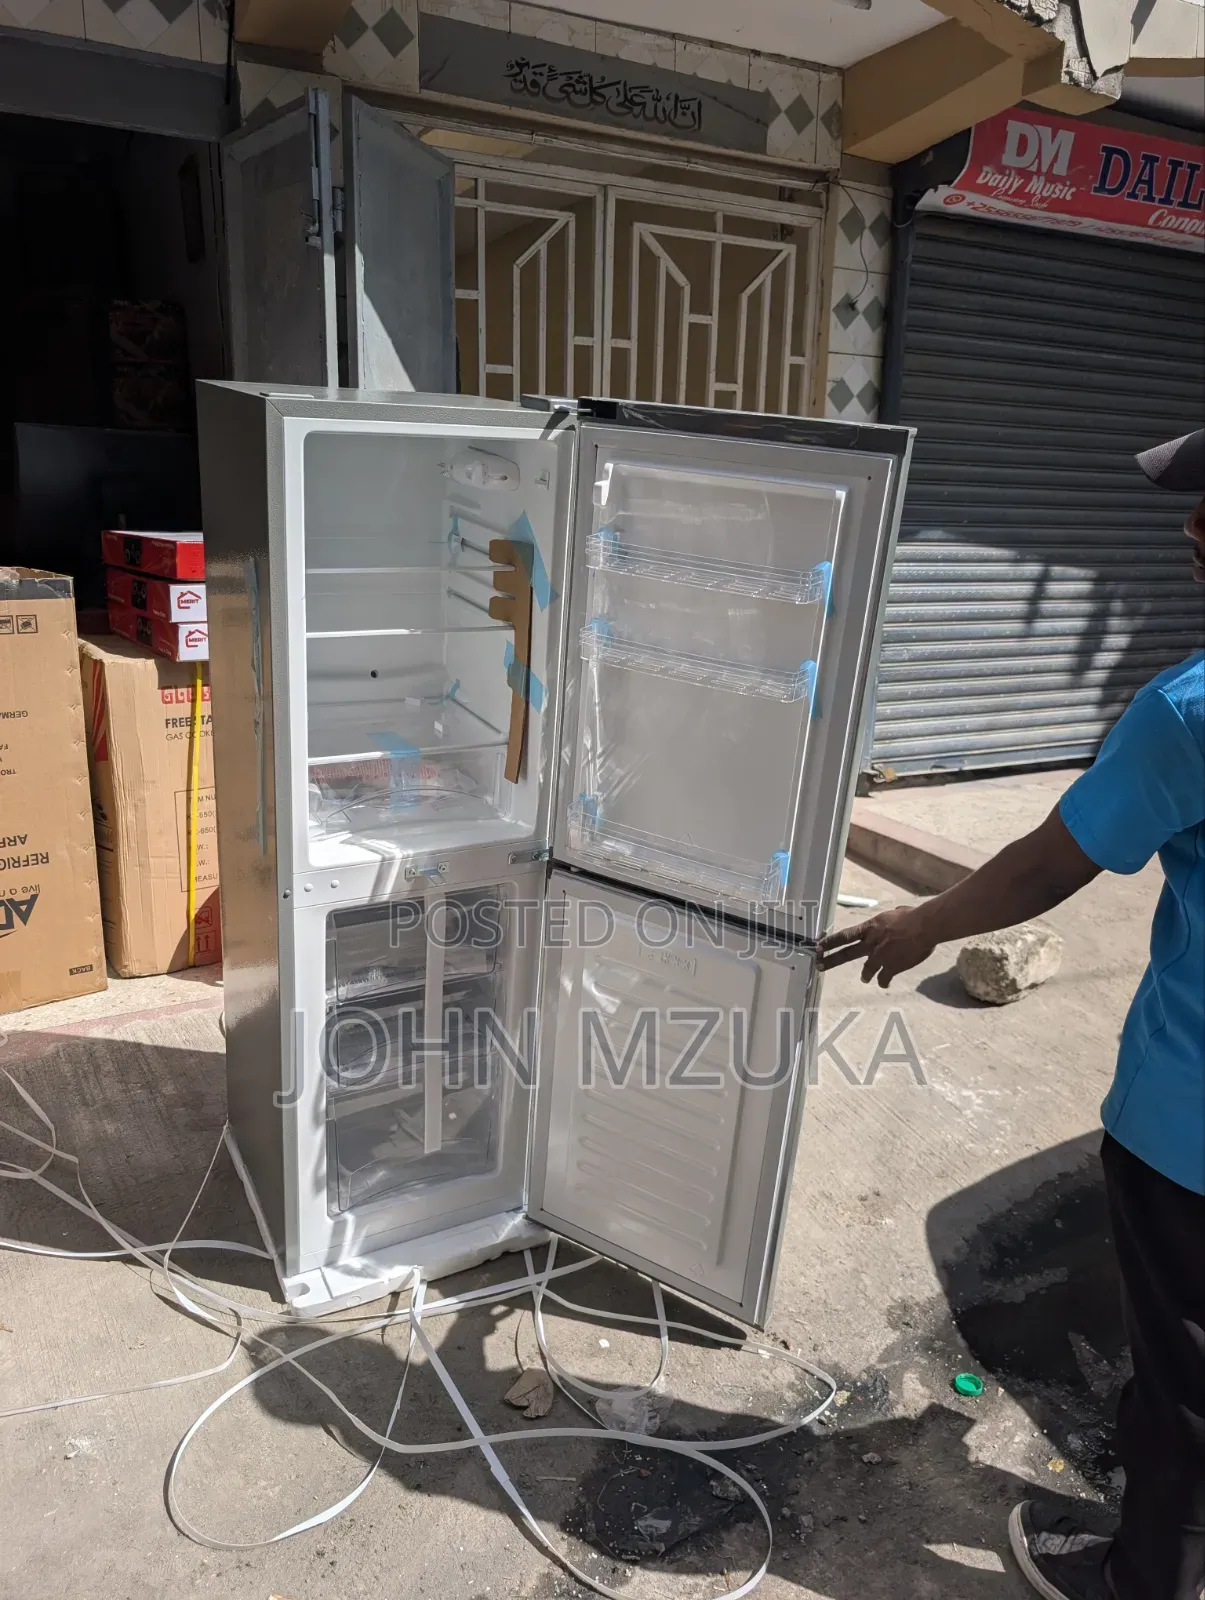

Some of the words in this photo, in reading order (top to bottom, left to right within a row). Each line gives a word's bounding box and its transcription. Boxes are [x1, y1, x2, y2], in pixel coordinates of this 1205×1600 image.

[1002, 119, 1075, 176] DM
[1091, 144, 1204, 213] DAIL
[976, 166, 1024, 196] Daily
[1025, 173, 1078, 201] Music
[0, 710, 28, 719] GERM
[166, 732, 183, 741] GAS
[10, 887, 17, 895] a
[21, 884, 40, 894] live
[71, 965, 91, 974] BACK
